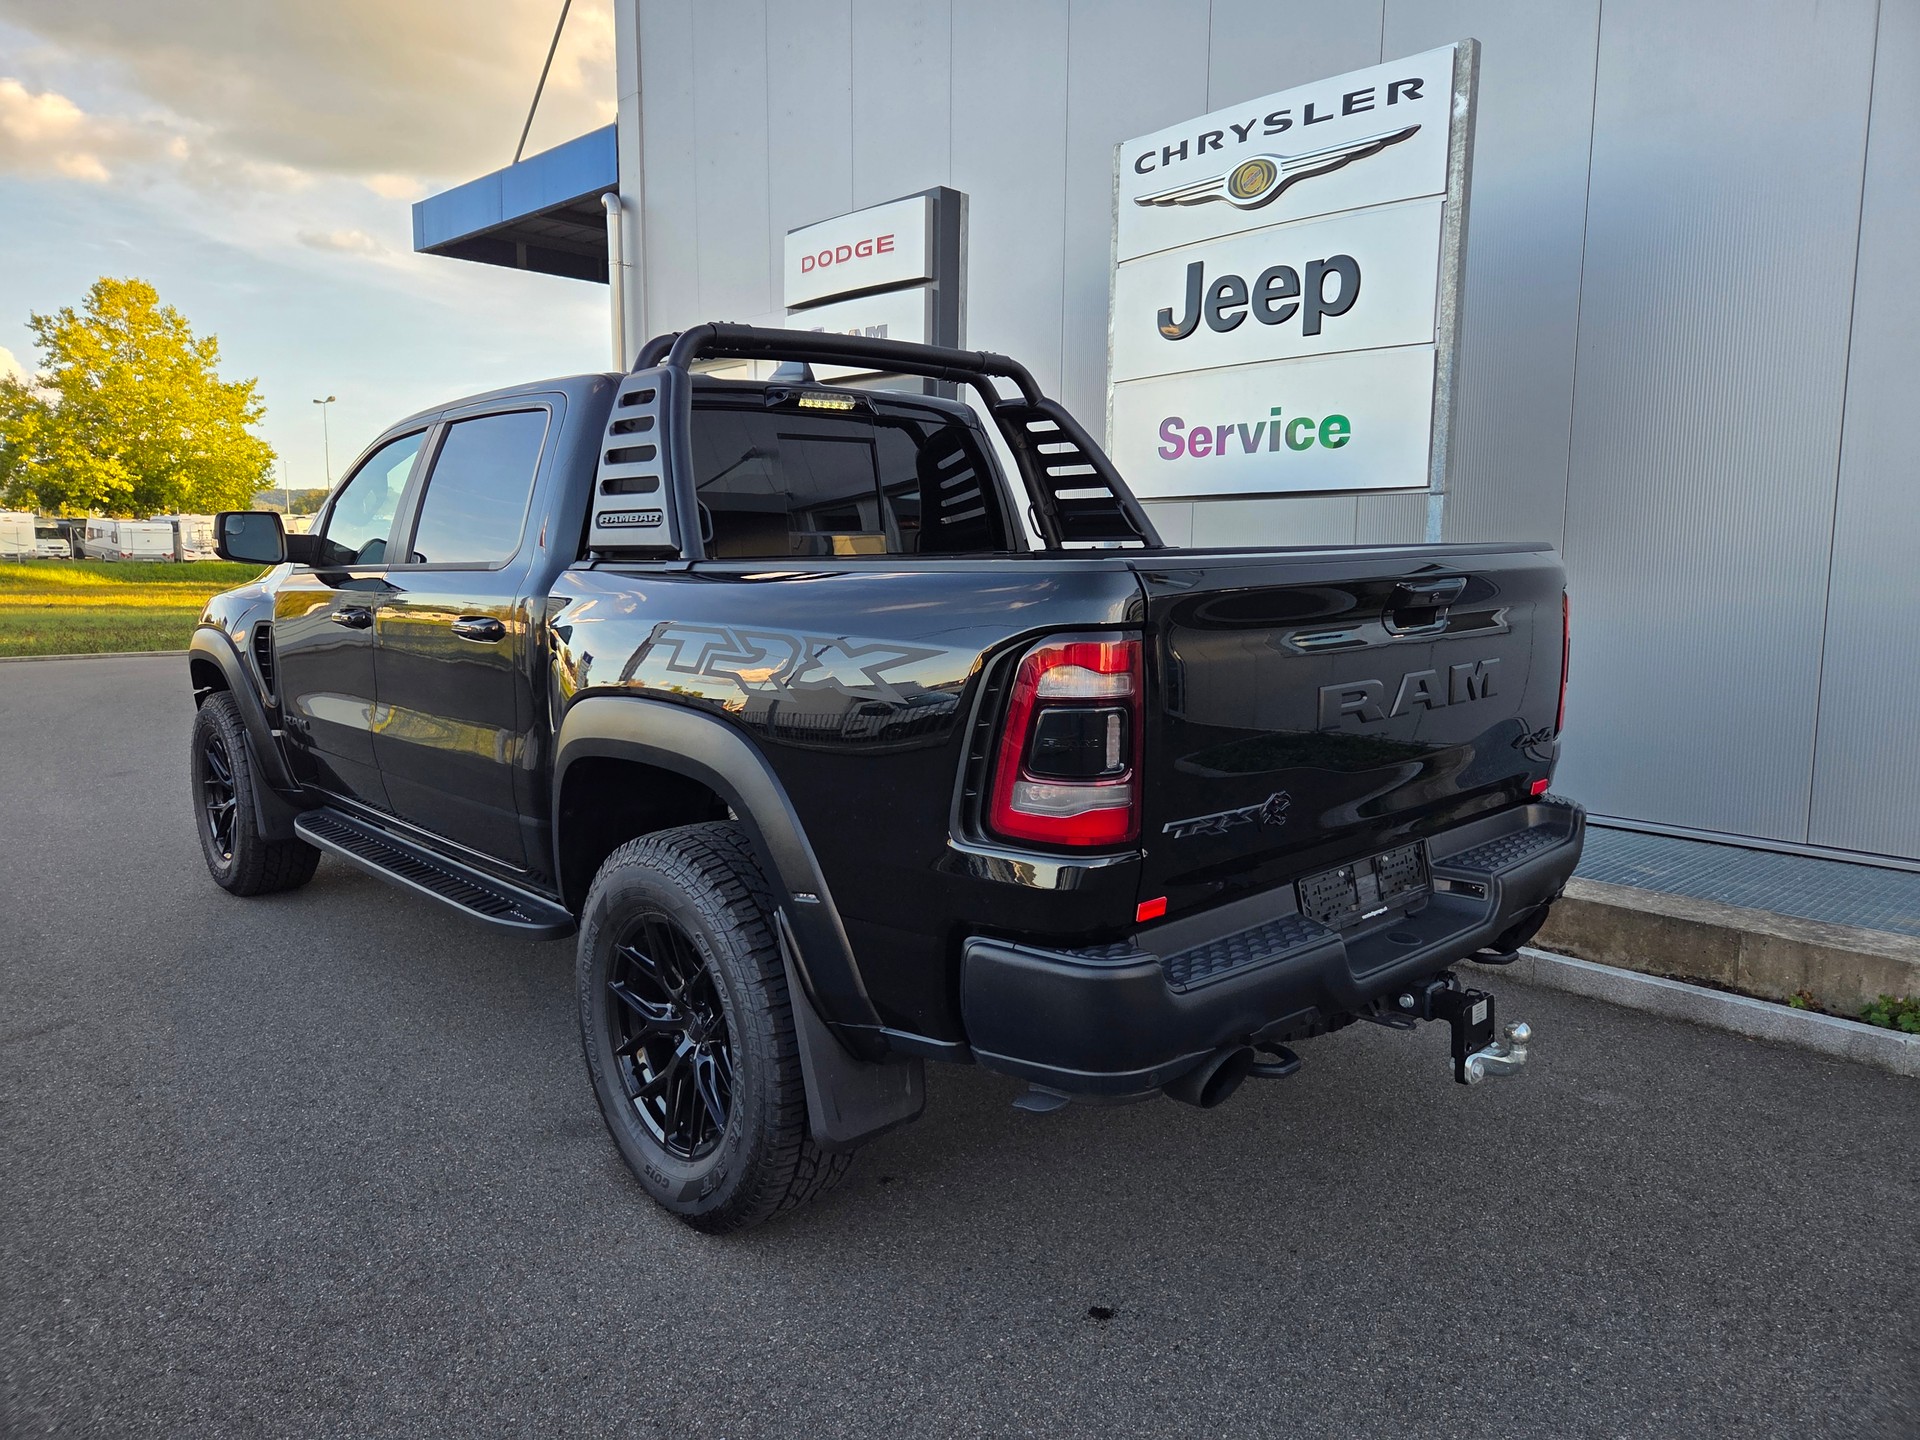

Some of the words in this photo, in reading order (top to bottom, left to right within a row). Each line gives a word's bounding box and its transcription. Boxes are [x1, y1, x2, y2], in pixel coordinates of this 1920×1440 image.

[1134, 77, 1425, 175] CHRYSLER
[801, 233, 895, 274] DODGE
[1157, 254, 1362, 341] Jeep
[1157, 406, 1351, 461] Service
[600, 514, 662, 524] RAMBAR
[649, 621, 949, 705] TRX
[1317, 657, 1500, 732] RAM
[1161, 803, 1265, 839] TRX
